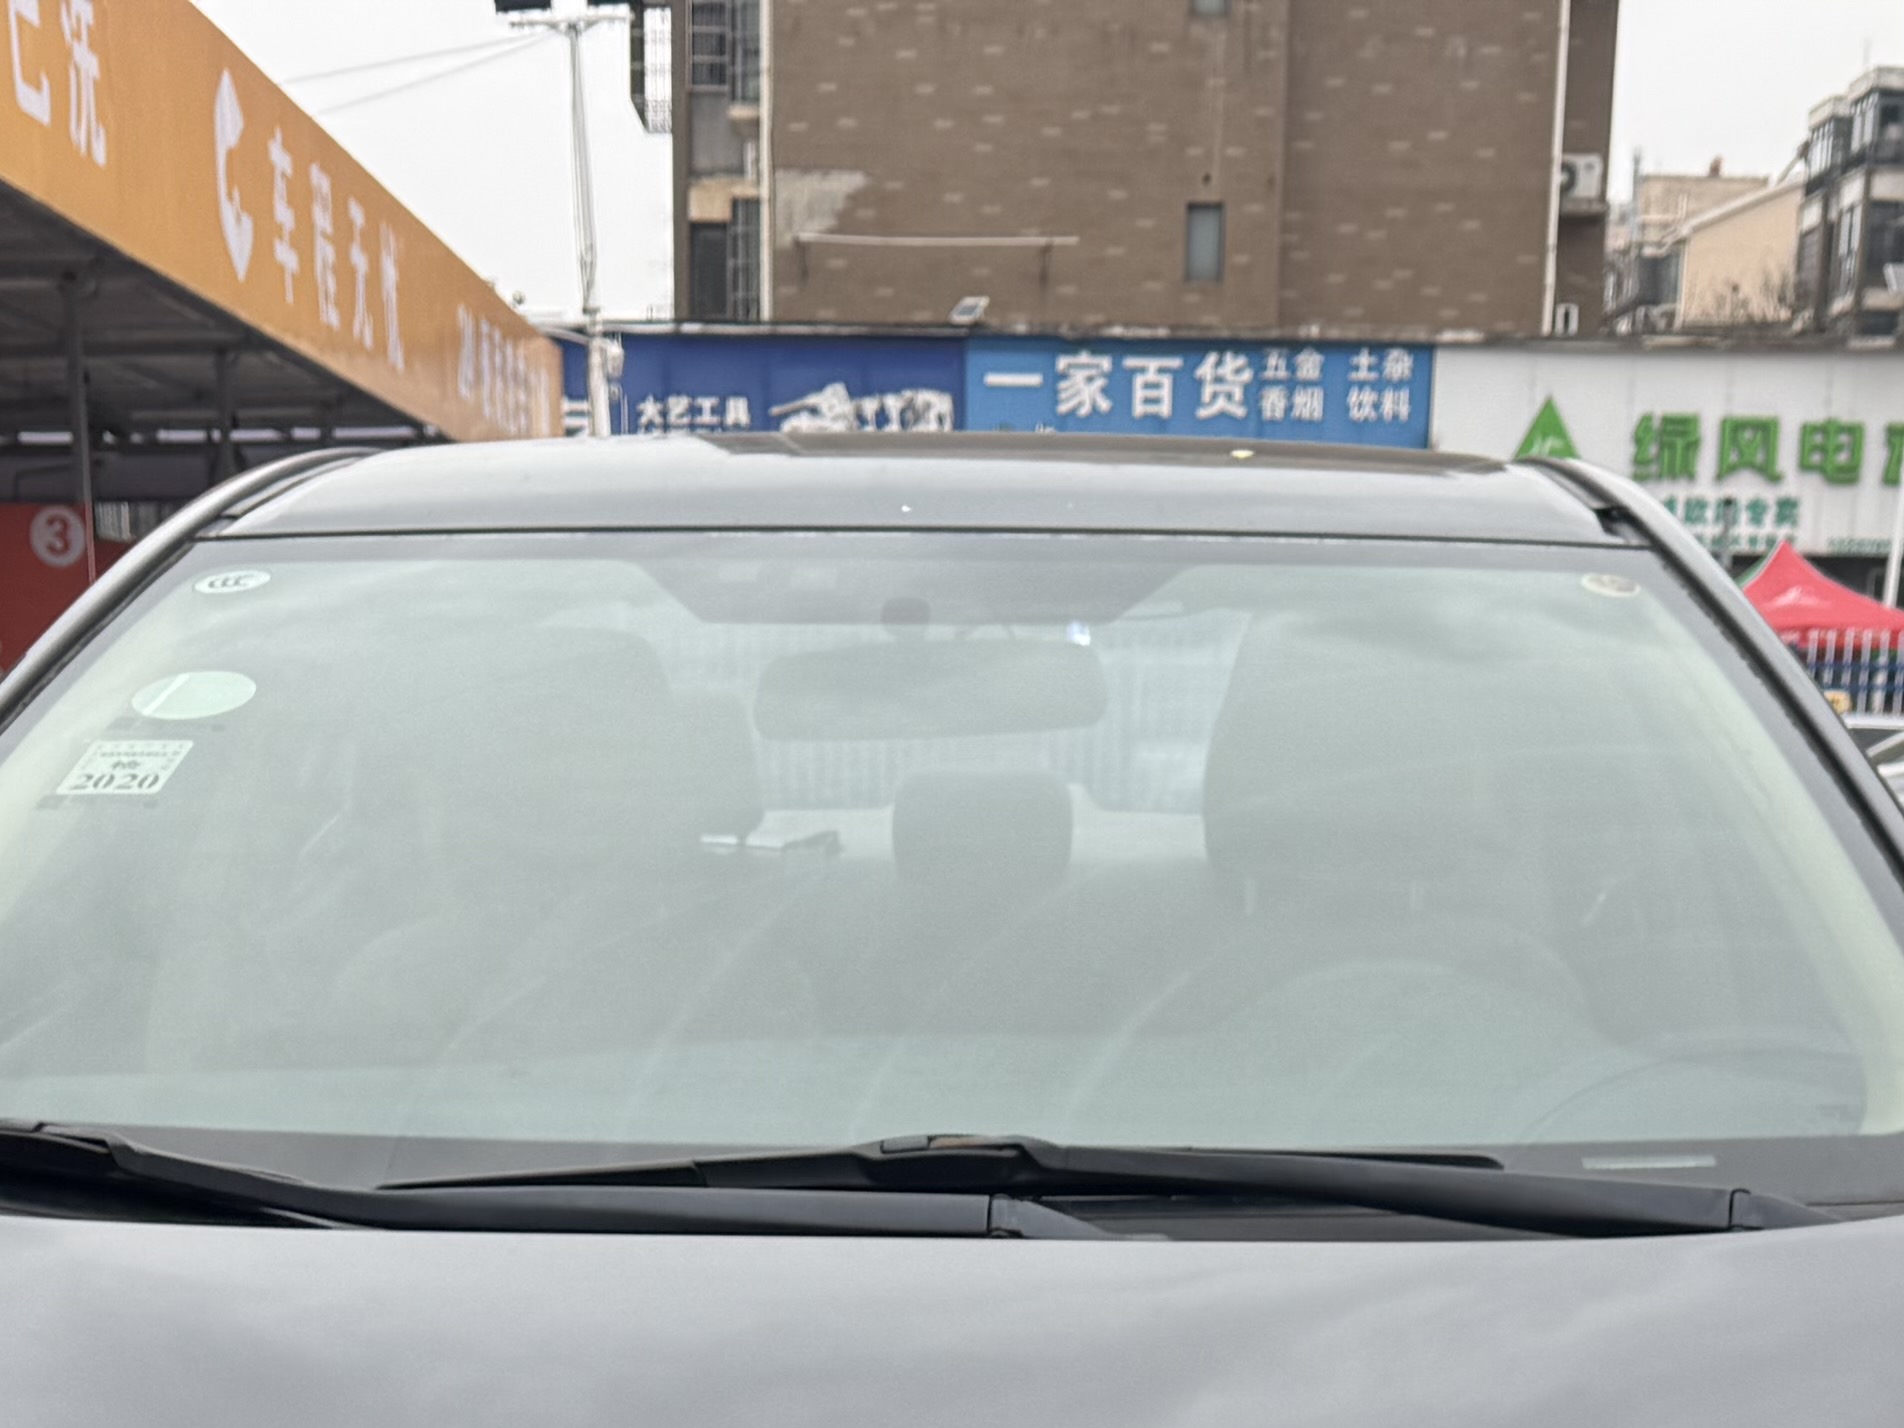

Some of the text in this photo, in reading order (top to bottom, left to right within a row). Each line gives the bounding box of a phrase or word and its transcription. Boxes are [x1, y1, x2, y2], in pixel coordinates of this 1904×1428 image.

[1260, 347, 1325, 381] 五金
[983, 350, 1254, 420] 一家百货
[68, 772, 161, 791] 2020
